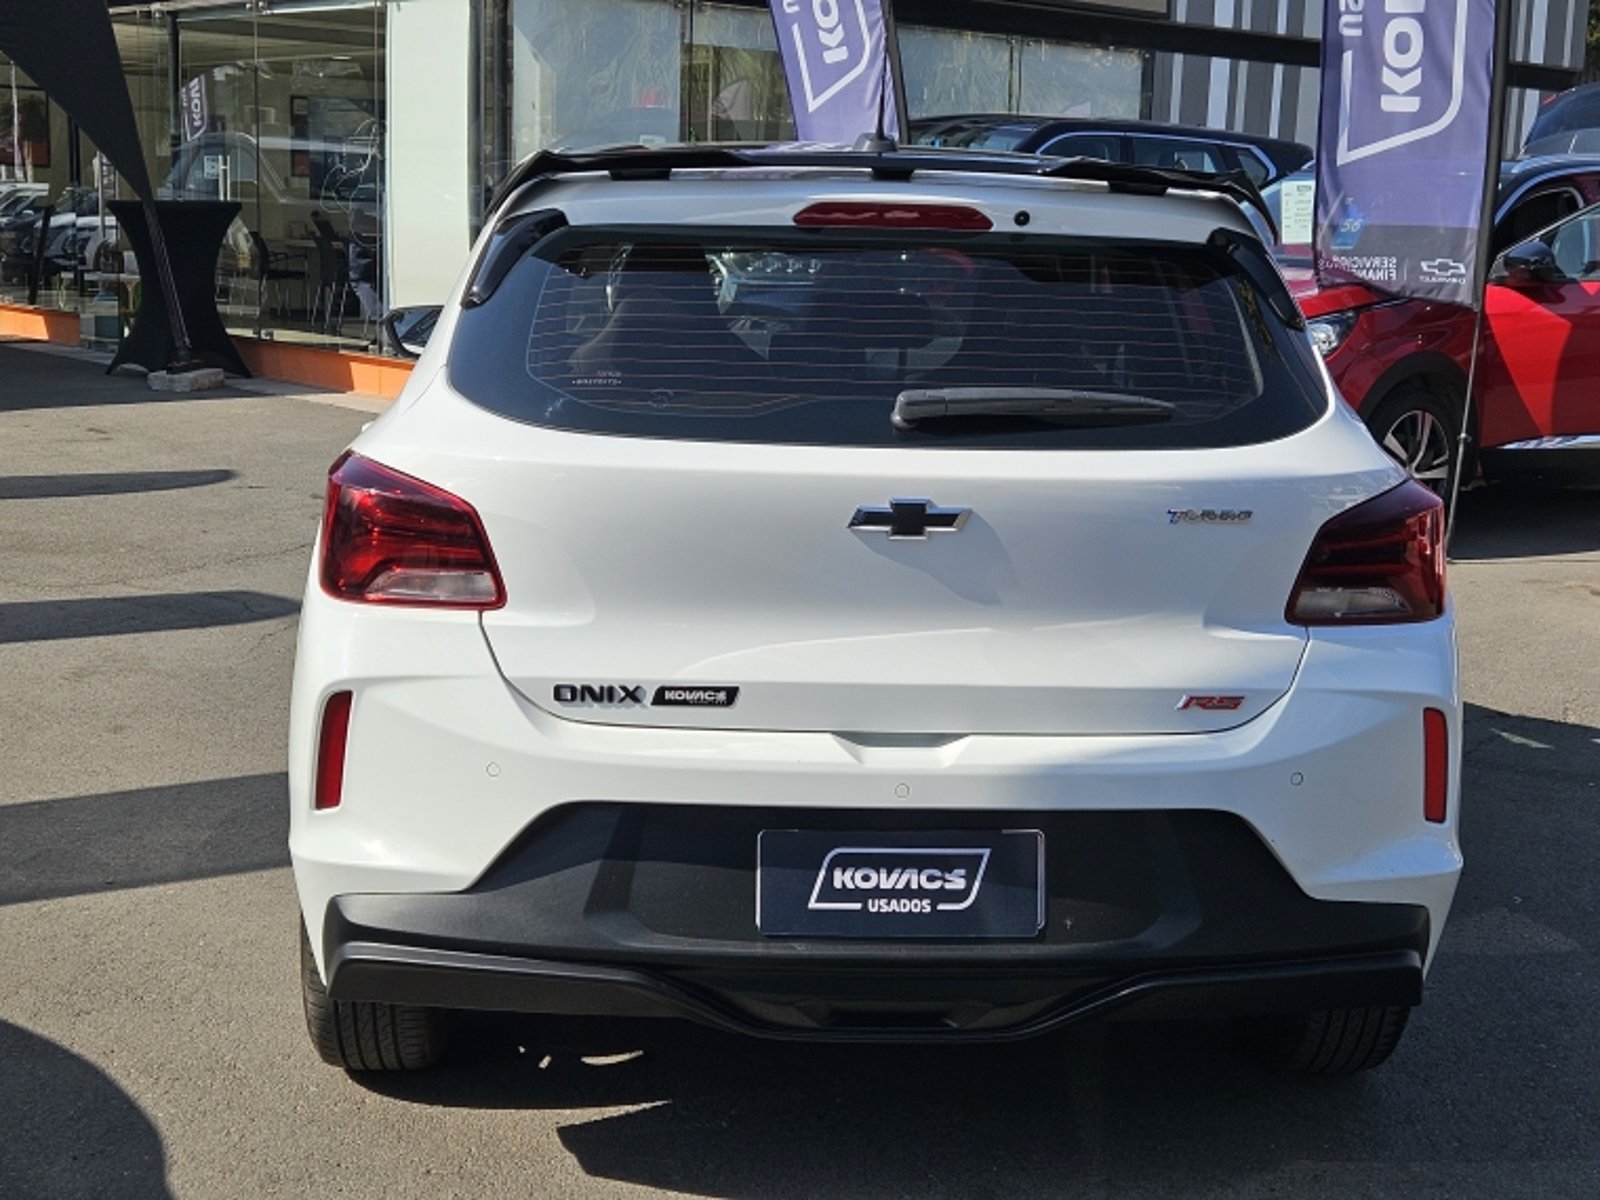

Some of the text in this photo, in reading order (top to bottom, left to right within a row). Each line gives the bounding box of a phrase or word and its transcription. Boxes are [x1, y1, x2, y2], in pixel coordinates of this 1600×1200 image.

[553, 684, 643, 703] ONIX
[664, 690, 727, 700] KOVACS
[1174, 695, 1244, 710] RS
[833, 867, 967, 889] KOVACS
[867, 899, 931, 912] USADOS
